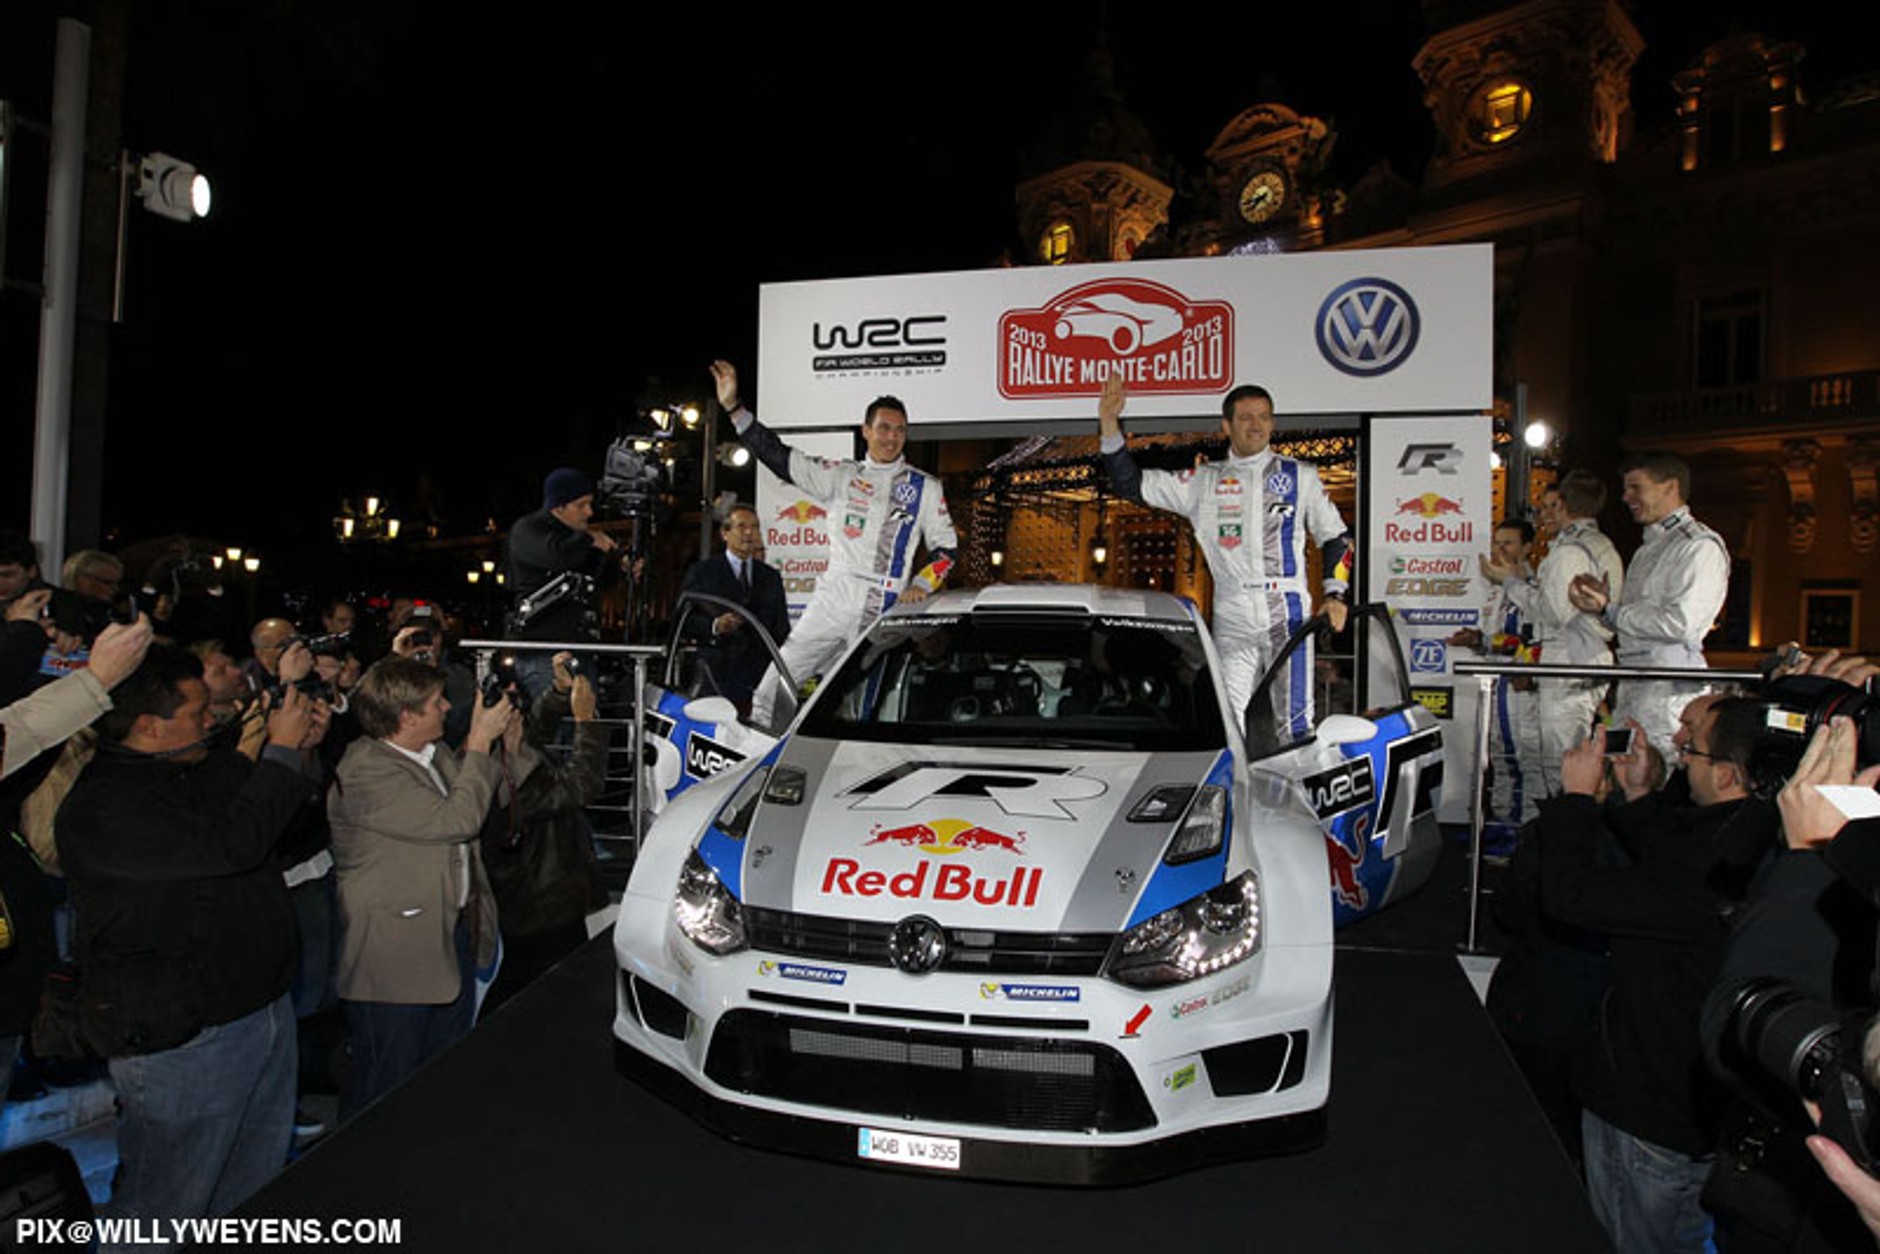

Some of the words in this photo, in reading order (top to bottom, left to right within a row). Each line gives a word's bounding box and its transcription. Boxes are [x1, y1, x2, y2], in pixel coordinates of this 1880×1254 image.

[813, 315, 946, 350] WRC
[1009, 323, 1047, 350] 2013
[1182, 315, 1223, 346] 2013
[1009, 341, 1074, 386] RALLYE
[1080, 334, 1223, 383] MONTE-CARLO
[768, 526, 801, 546] Red
[1385, 523, 1427, 543] Red
[1431, 523, 1473, 543] Bull
[784, 559, 829, 573] Castrol
[1407, 558, 1463, 575] Castrol
[1385, 578, 1471, 597] EDGE
[1408, 611, 1477, 622] MICHELIN
[1418, 645, 1440, 663] ZF
[821, 858, 930, 898] Red
[933, 864, 1043, 908] Bull
[1010, 987, 1078, 998] MICHELIN
[929, 1143, 958, 1162] 355
